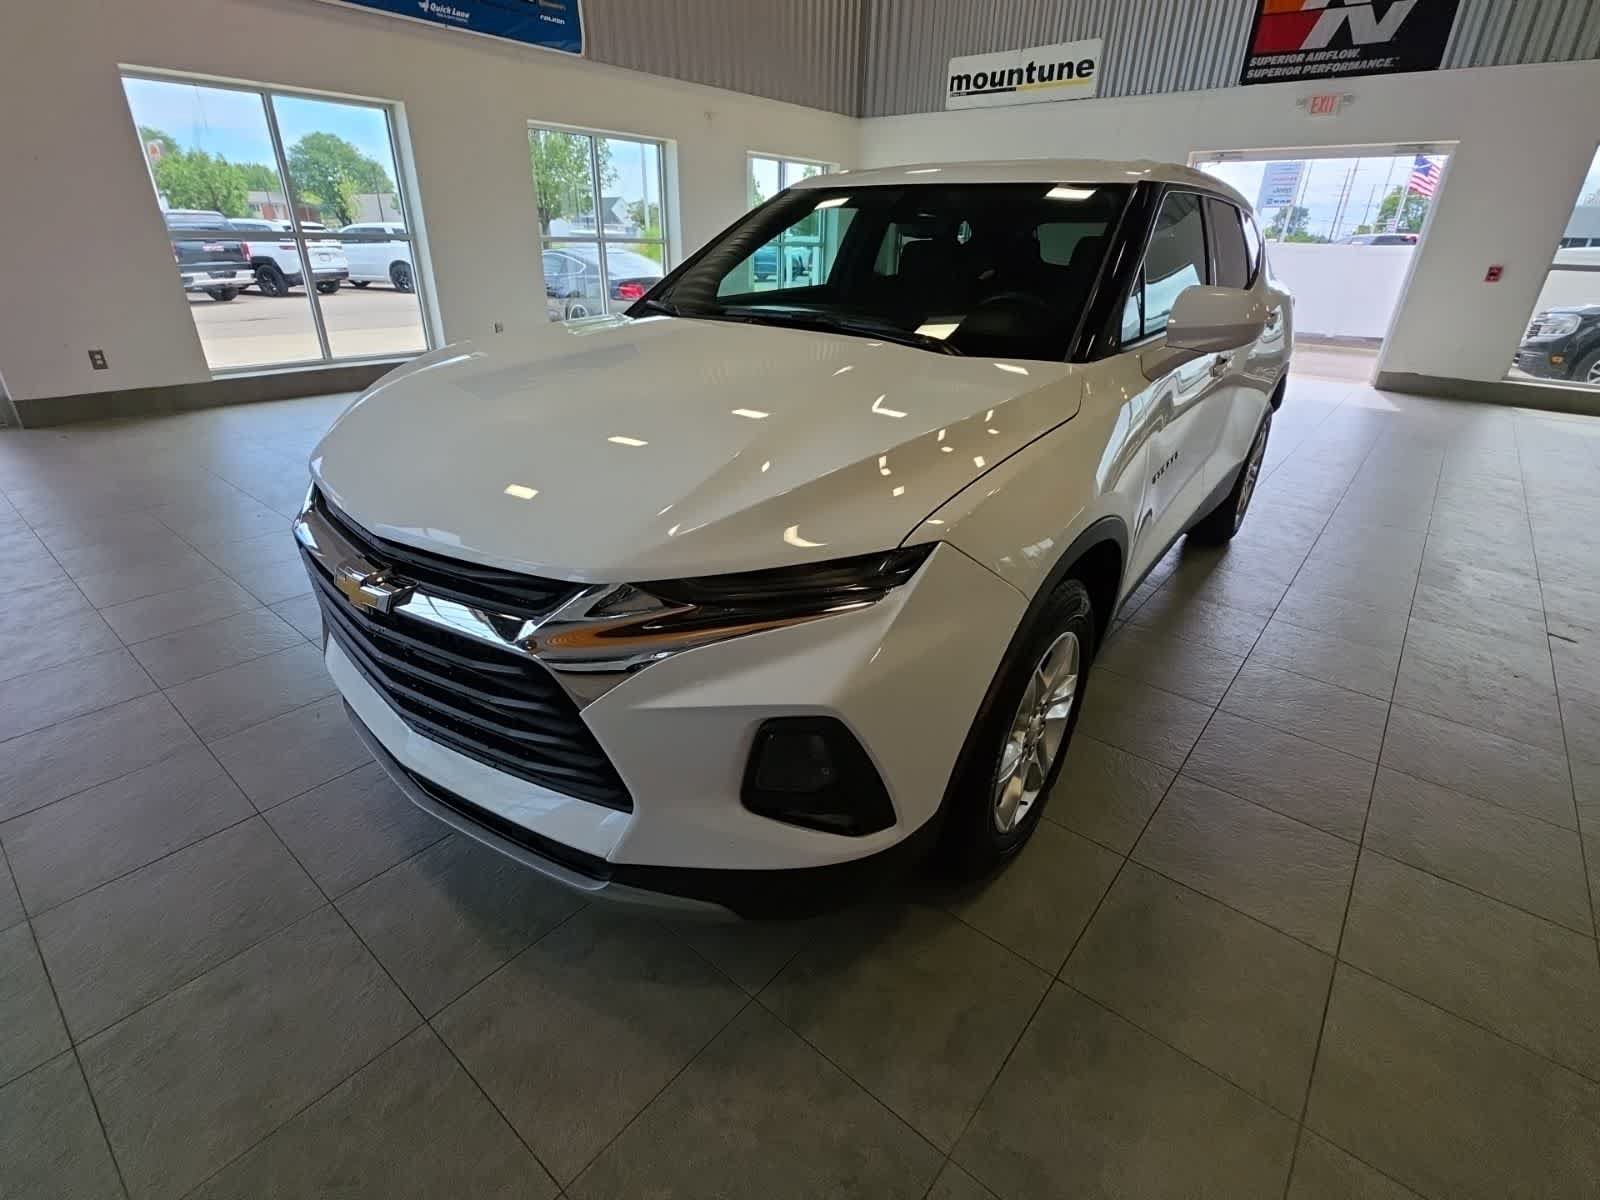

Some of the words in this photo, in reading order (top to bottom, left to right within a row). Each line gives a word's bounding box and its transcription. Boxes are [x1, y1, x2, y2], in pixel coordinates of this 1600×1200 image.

[430, 2, 451, 14] Quick
[1249, 53, 1304, 66] SUPERIOR
[1305, 48, 1360, 62] AIRFLOW.
[949, 57, 1095, 92] mountune
[1246, 66, 1301, 78] SUPERIOR
[1310, 95, 1337, 113] EXIT
